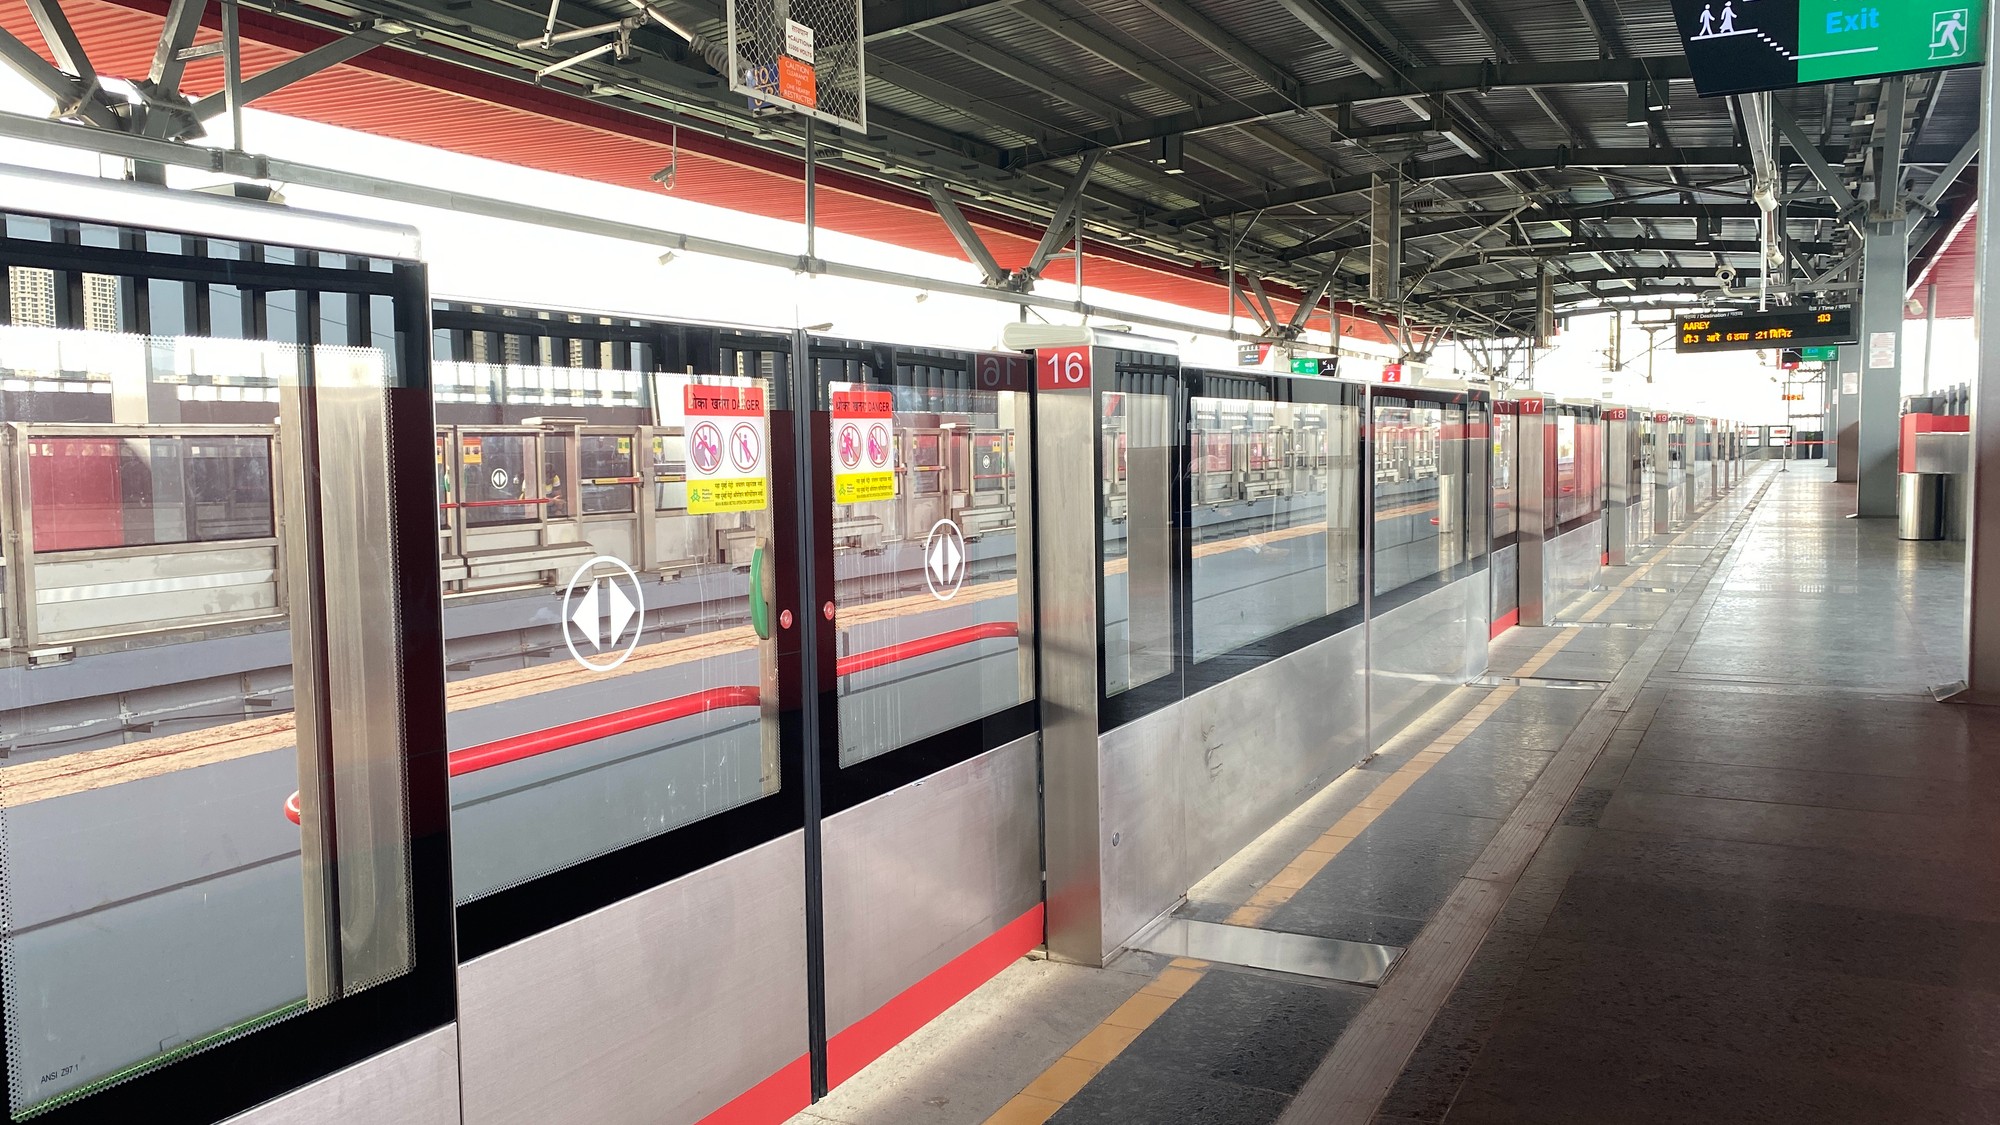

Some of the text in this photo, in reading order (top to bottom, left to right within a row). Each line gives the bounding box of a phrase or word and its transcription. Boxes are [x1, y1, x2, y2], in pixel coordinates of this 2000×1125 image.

[1826, 7, 1880, 34] Exit
[790, 34, 810, 47] CAUTION
[785, 60, 810, 76] CAUTION
[795, 79, 802, 87] TO
[783, 89, 814, 106] RESTRICTED
[1683, 313, 1831, 331] AAREY :03
[1047, 352, 1084, 383] 16
[1387, 371, 1396, 381] 2
[868, 401, 890, 412] DANGER
[1523, 400, 1540, 412] 17
[1612, 410, 1625, 419] 18
[1657, 414, 1667, 422] 19
[41, 1071, 58, 1084] ANSI
